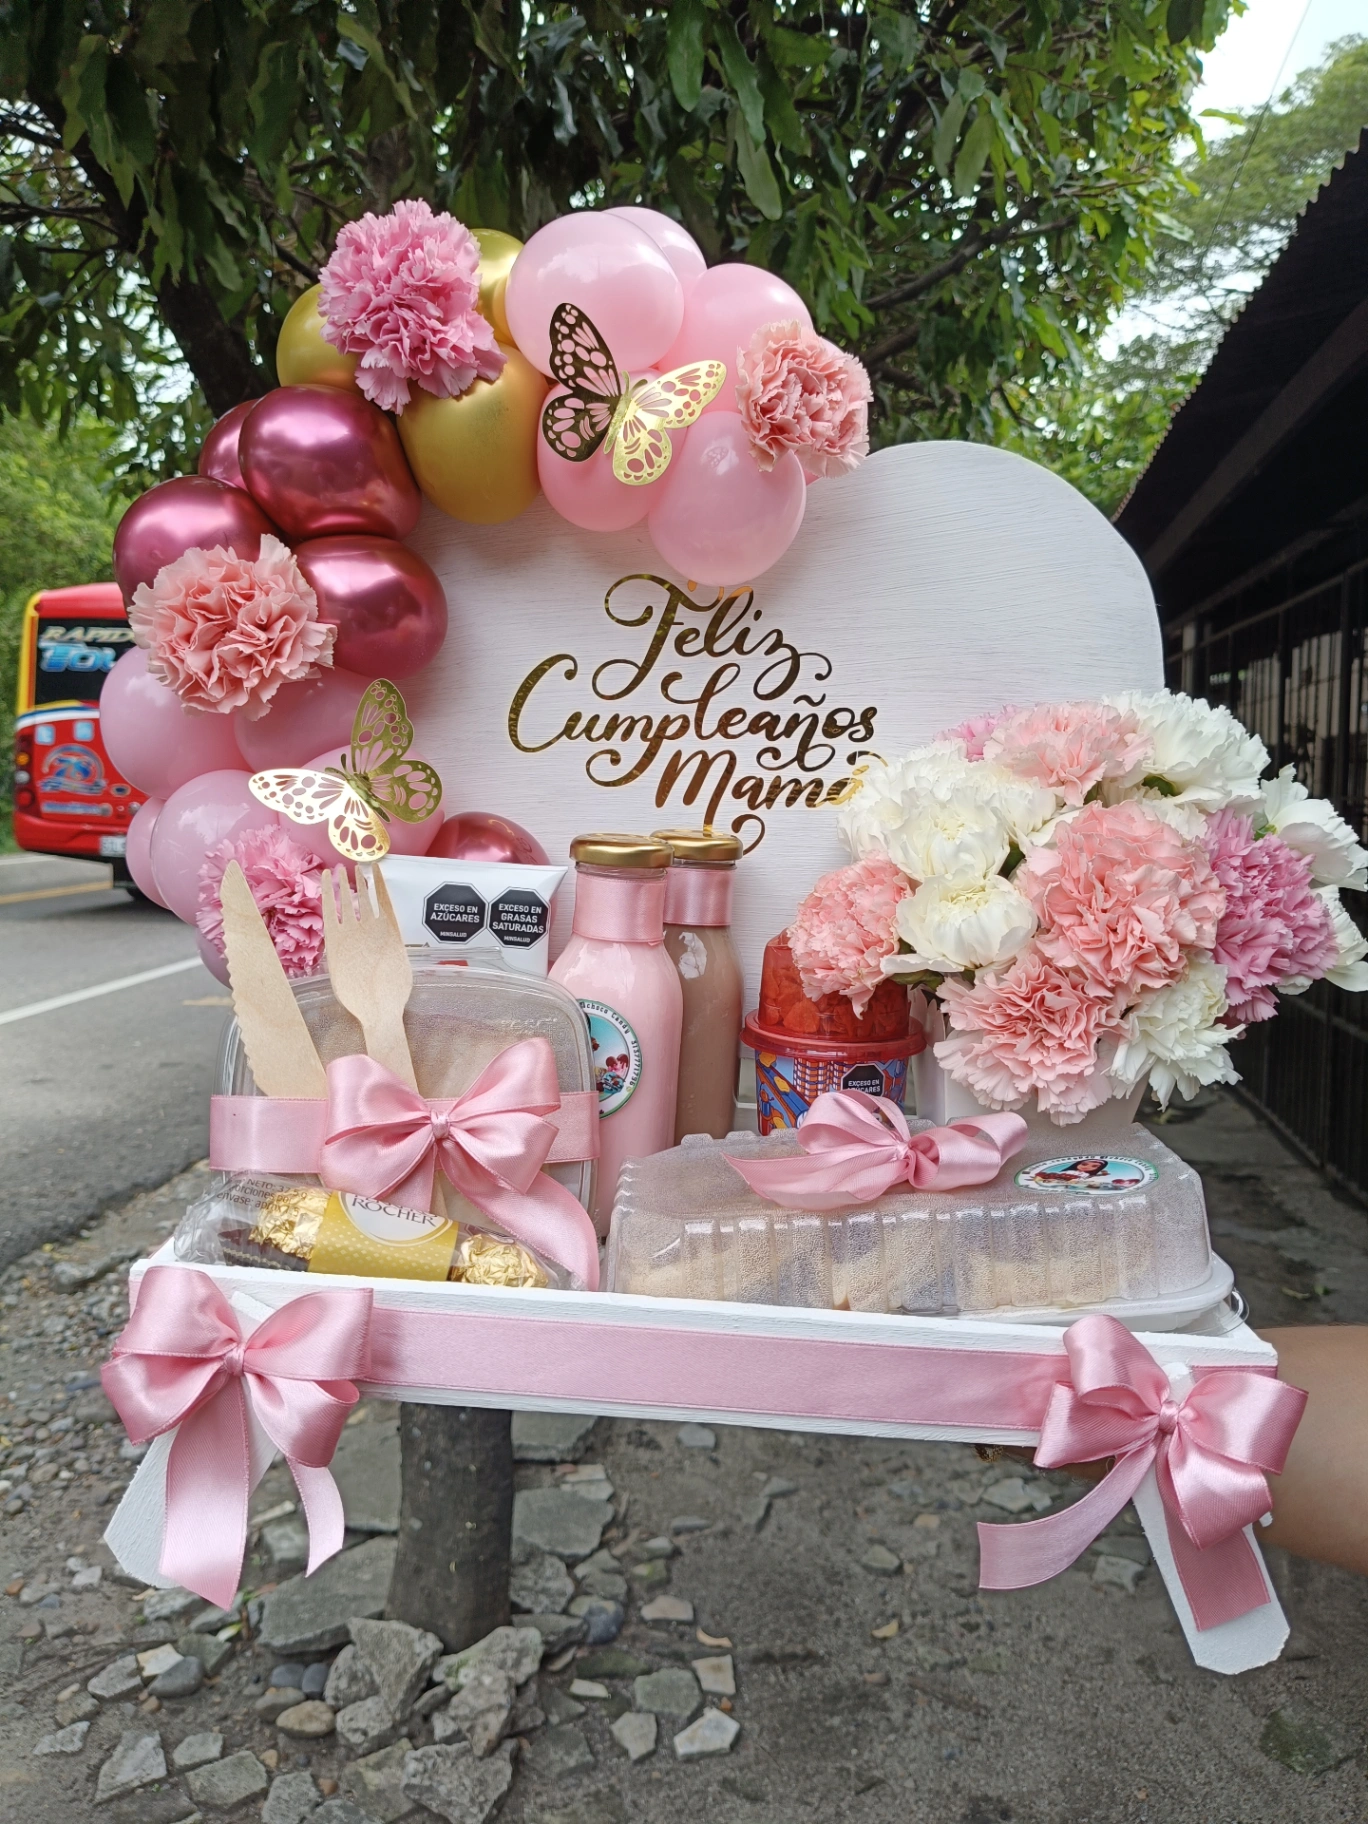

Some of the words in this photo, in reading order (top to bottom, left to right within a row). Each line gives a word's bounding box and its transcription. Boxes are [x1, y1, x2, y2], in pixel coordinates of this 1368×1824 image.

[592, 574, 832, 700] Feliz
[507, 653, 878, 788] Cumpleaños
[433, 903, 466, 912] EXCESO
[467, 905, 478, 913] EN
[498, 903, 529, 913] EXCESO
[531, 906, 542, 914] EN
[430, 910, 480, 923] AZÚCARES
[501, 912, 538, 923] GRASAS
[492, 921, 544, 933] SATURADAS
[351, 1197, 437, 1228] ROCHER
